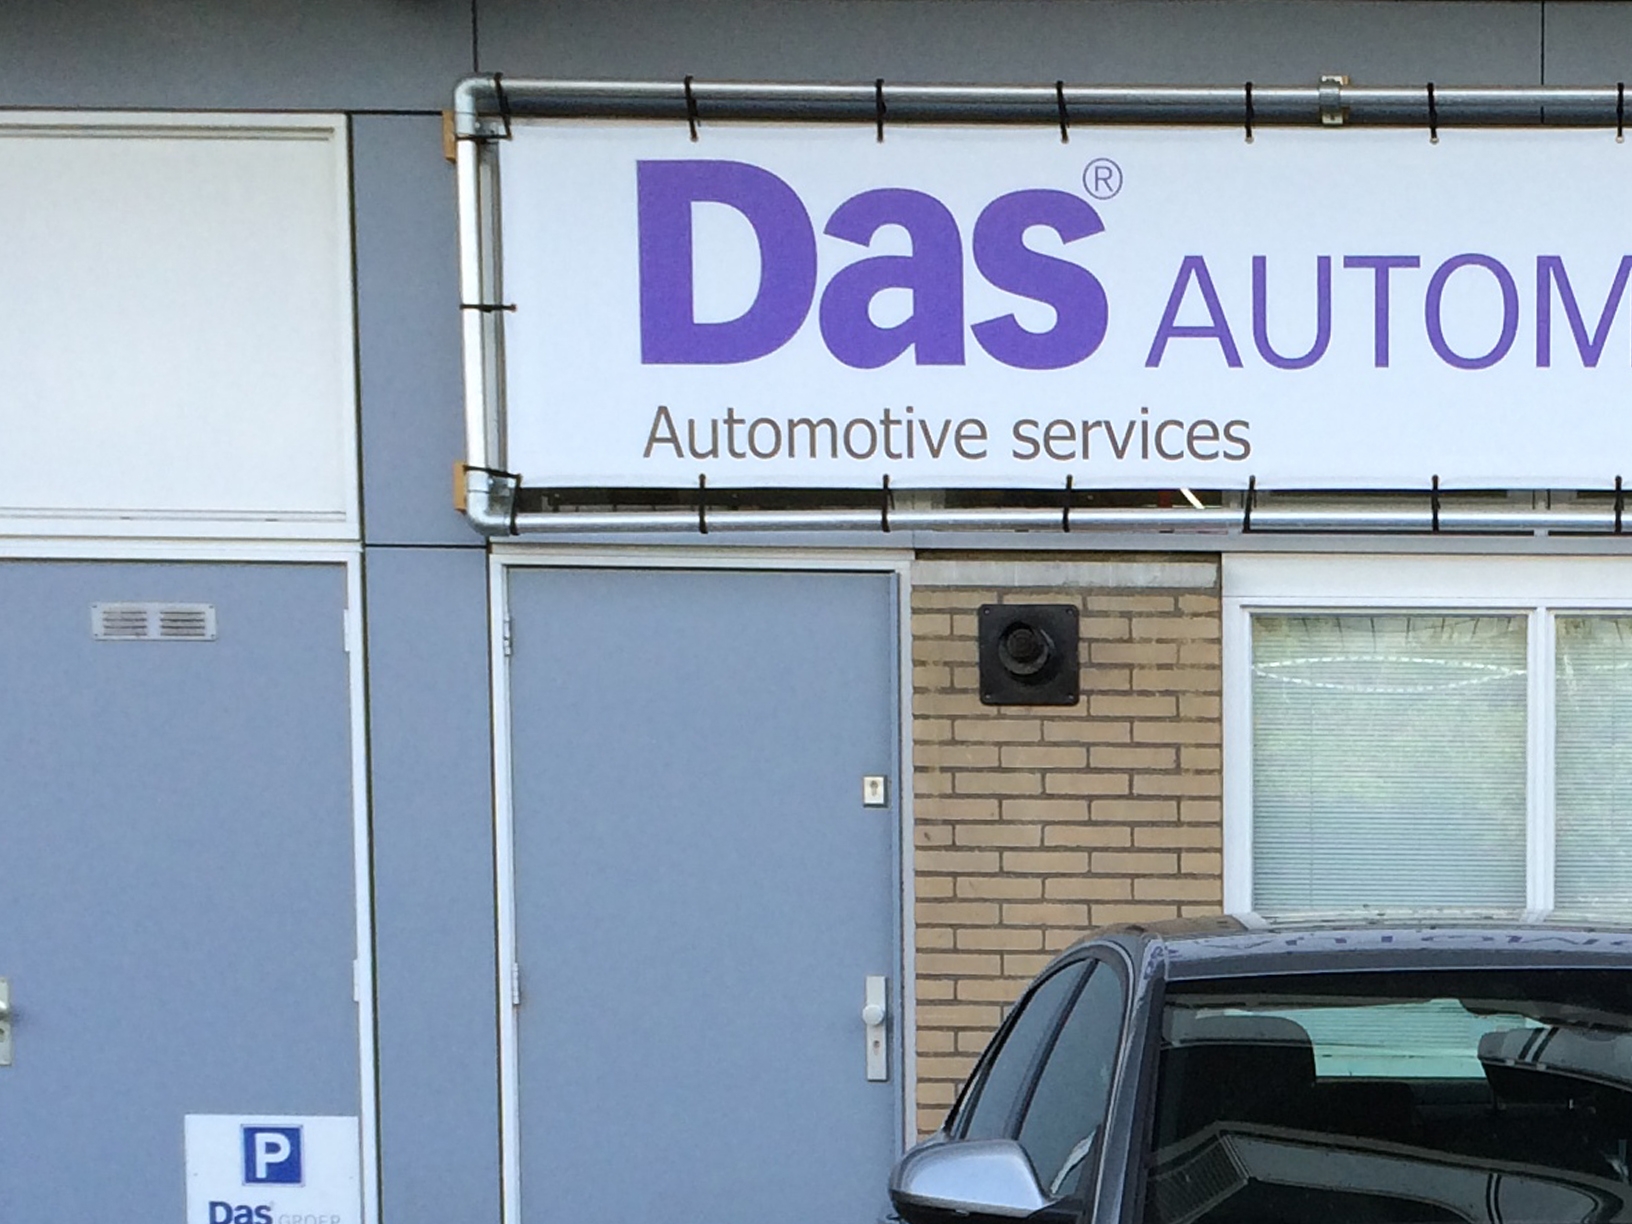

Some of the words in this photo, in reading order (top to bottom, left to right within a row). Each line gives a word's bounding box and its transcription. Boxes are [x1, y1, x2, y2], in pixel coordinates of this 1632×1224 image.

[637, 159, 1108, 370] Das
[643, 405, 989, 461] Automotive
[1011, 407, 1252, 462] services
[255, 1132, 291, 1179] P
